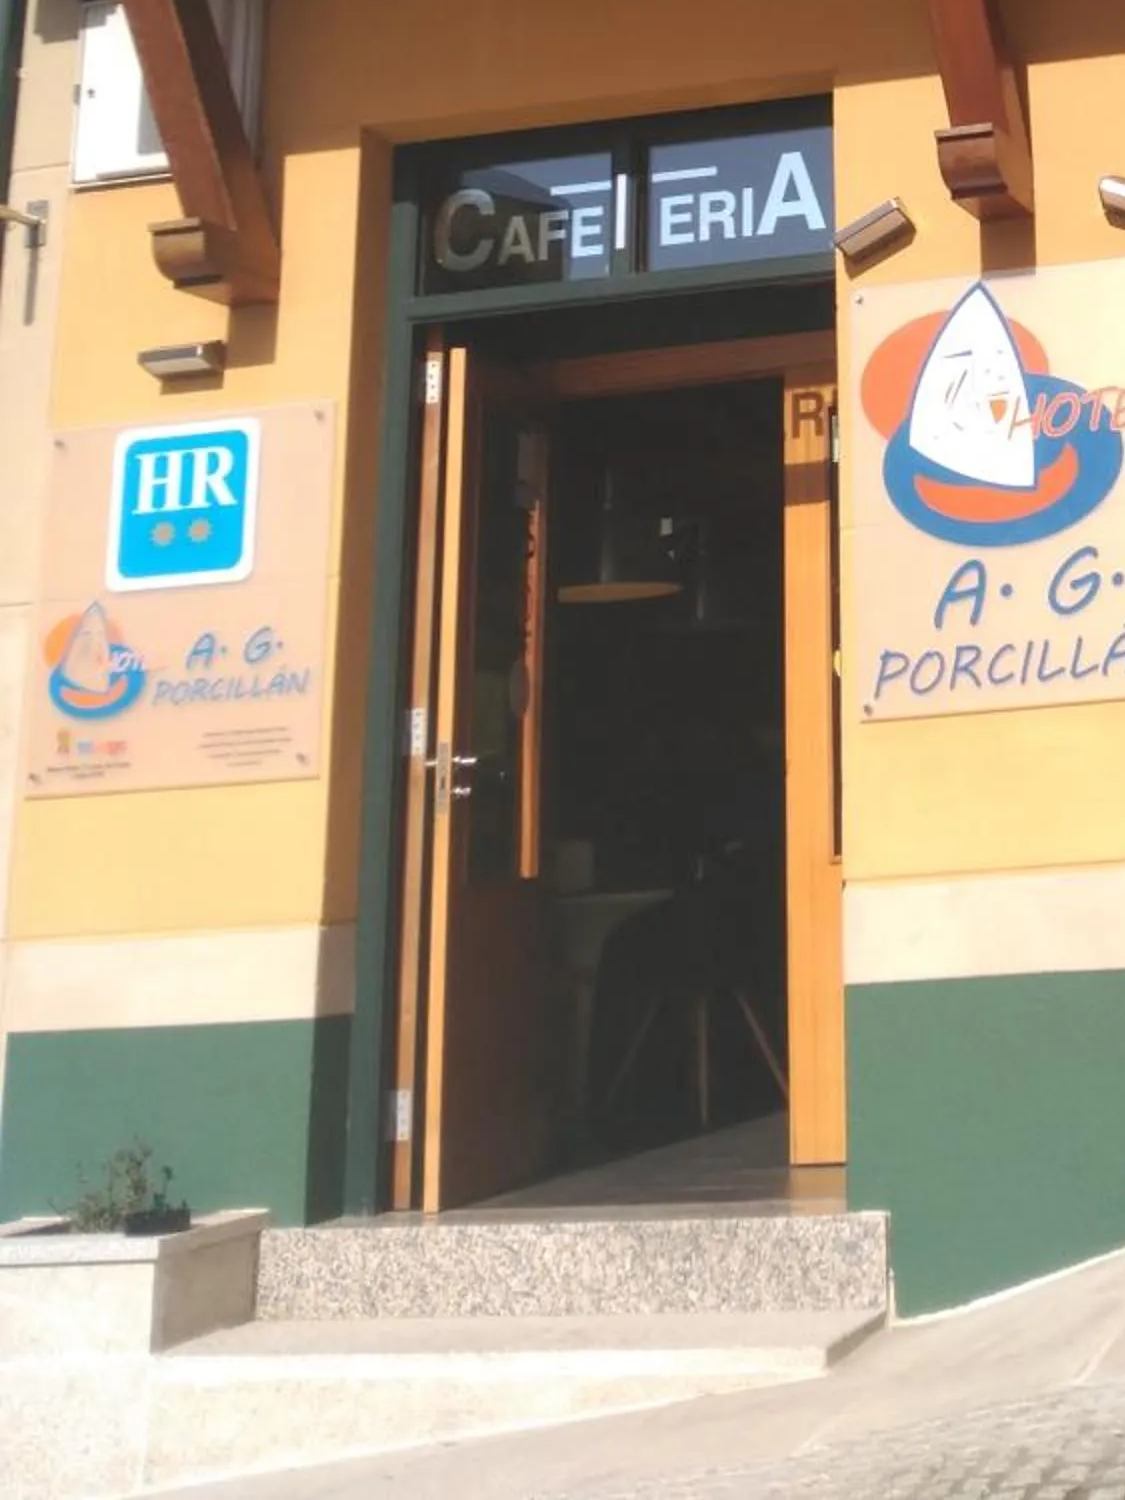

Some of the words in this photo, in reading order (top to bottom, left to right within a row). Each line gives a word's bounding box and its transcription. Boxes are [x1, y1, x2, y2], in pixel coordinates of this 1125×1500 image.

[434, 151, 826, 271] CAFETERIA
[132, 445, 237, 514] HR
[151, 664, 312, 708] PORCILLÁN
